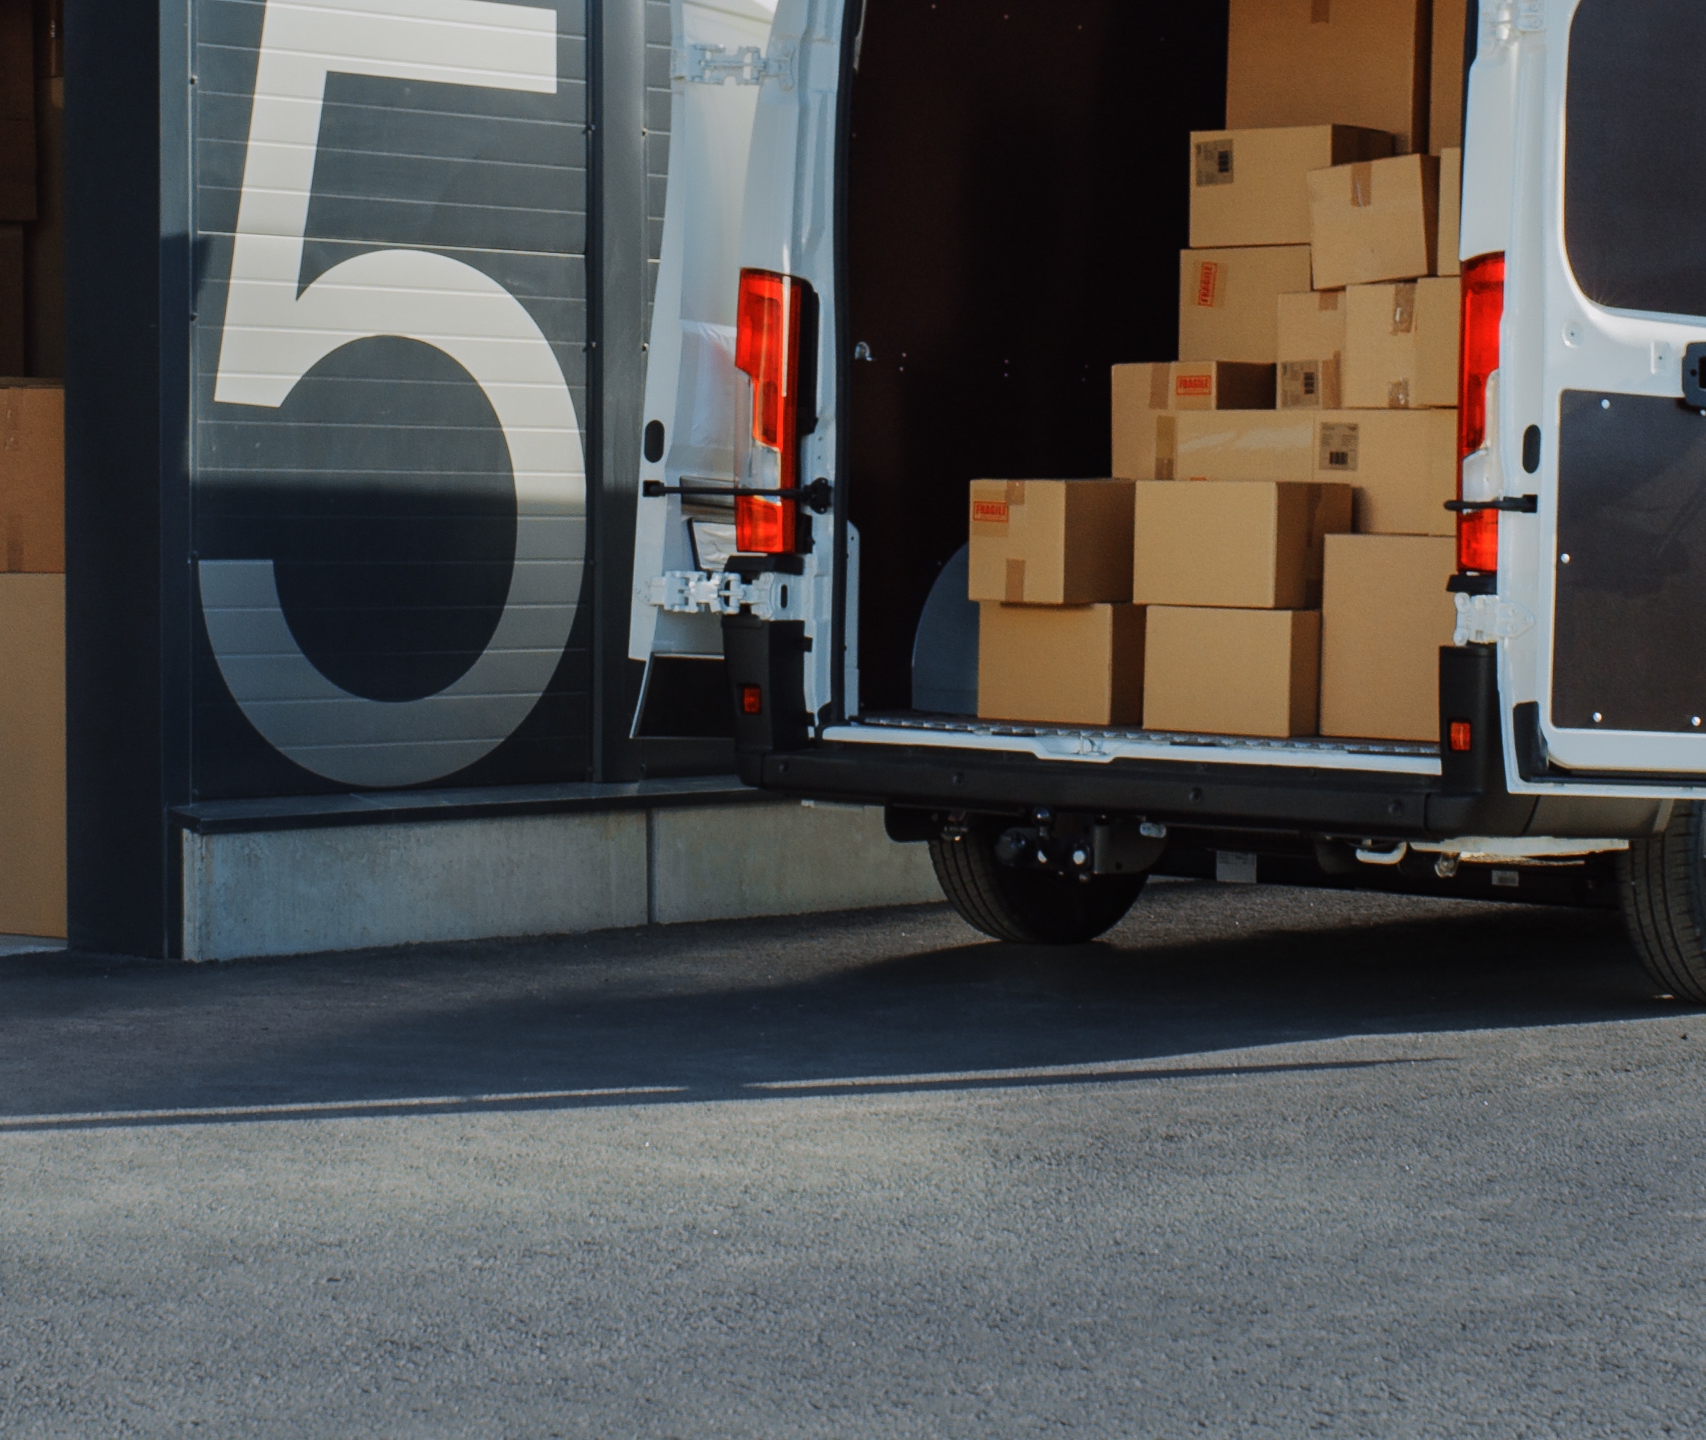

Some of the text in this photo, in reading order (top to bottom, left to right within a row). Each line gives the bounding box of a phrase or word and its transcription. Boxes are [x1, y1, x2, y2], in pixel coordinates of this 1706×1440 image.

[1200, 265, 1213, 303] FRAGILE
[1179, 378, 1209, 388] FRAGILE
[975, 504, 1007, 516] FRAGILE
